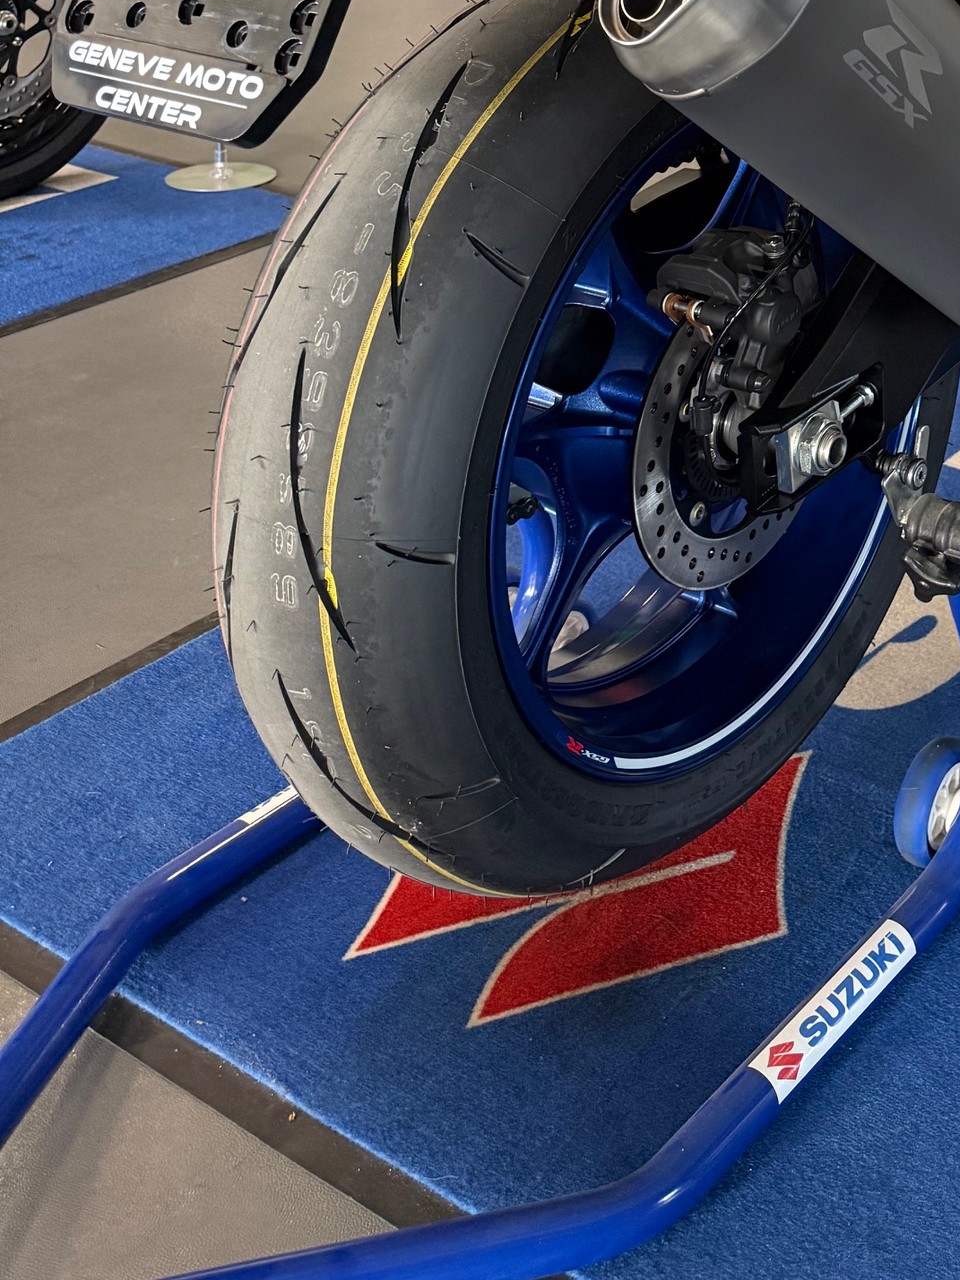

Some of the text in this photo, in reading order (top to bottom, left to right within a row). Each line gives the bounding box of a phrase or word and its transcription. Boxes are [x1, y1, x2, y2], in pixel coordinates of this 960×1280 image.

[69, 40, 264, 100] GENEVE MOTO
[95, 85, 203, 130] CENTER
[799, 931, 906, 1048] SUZUKI
